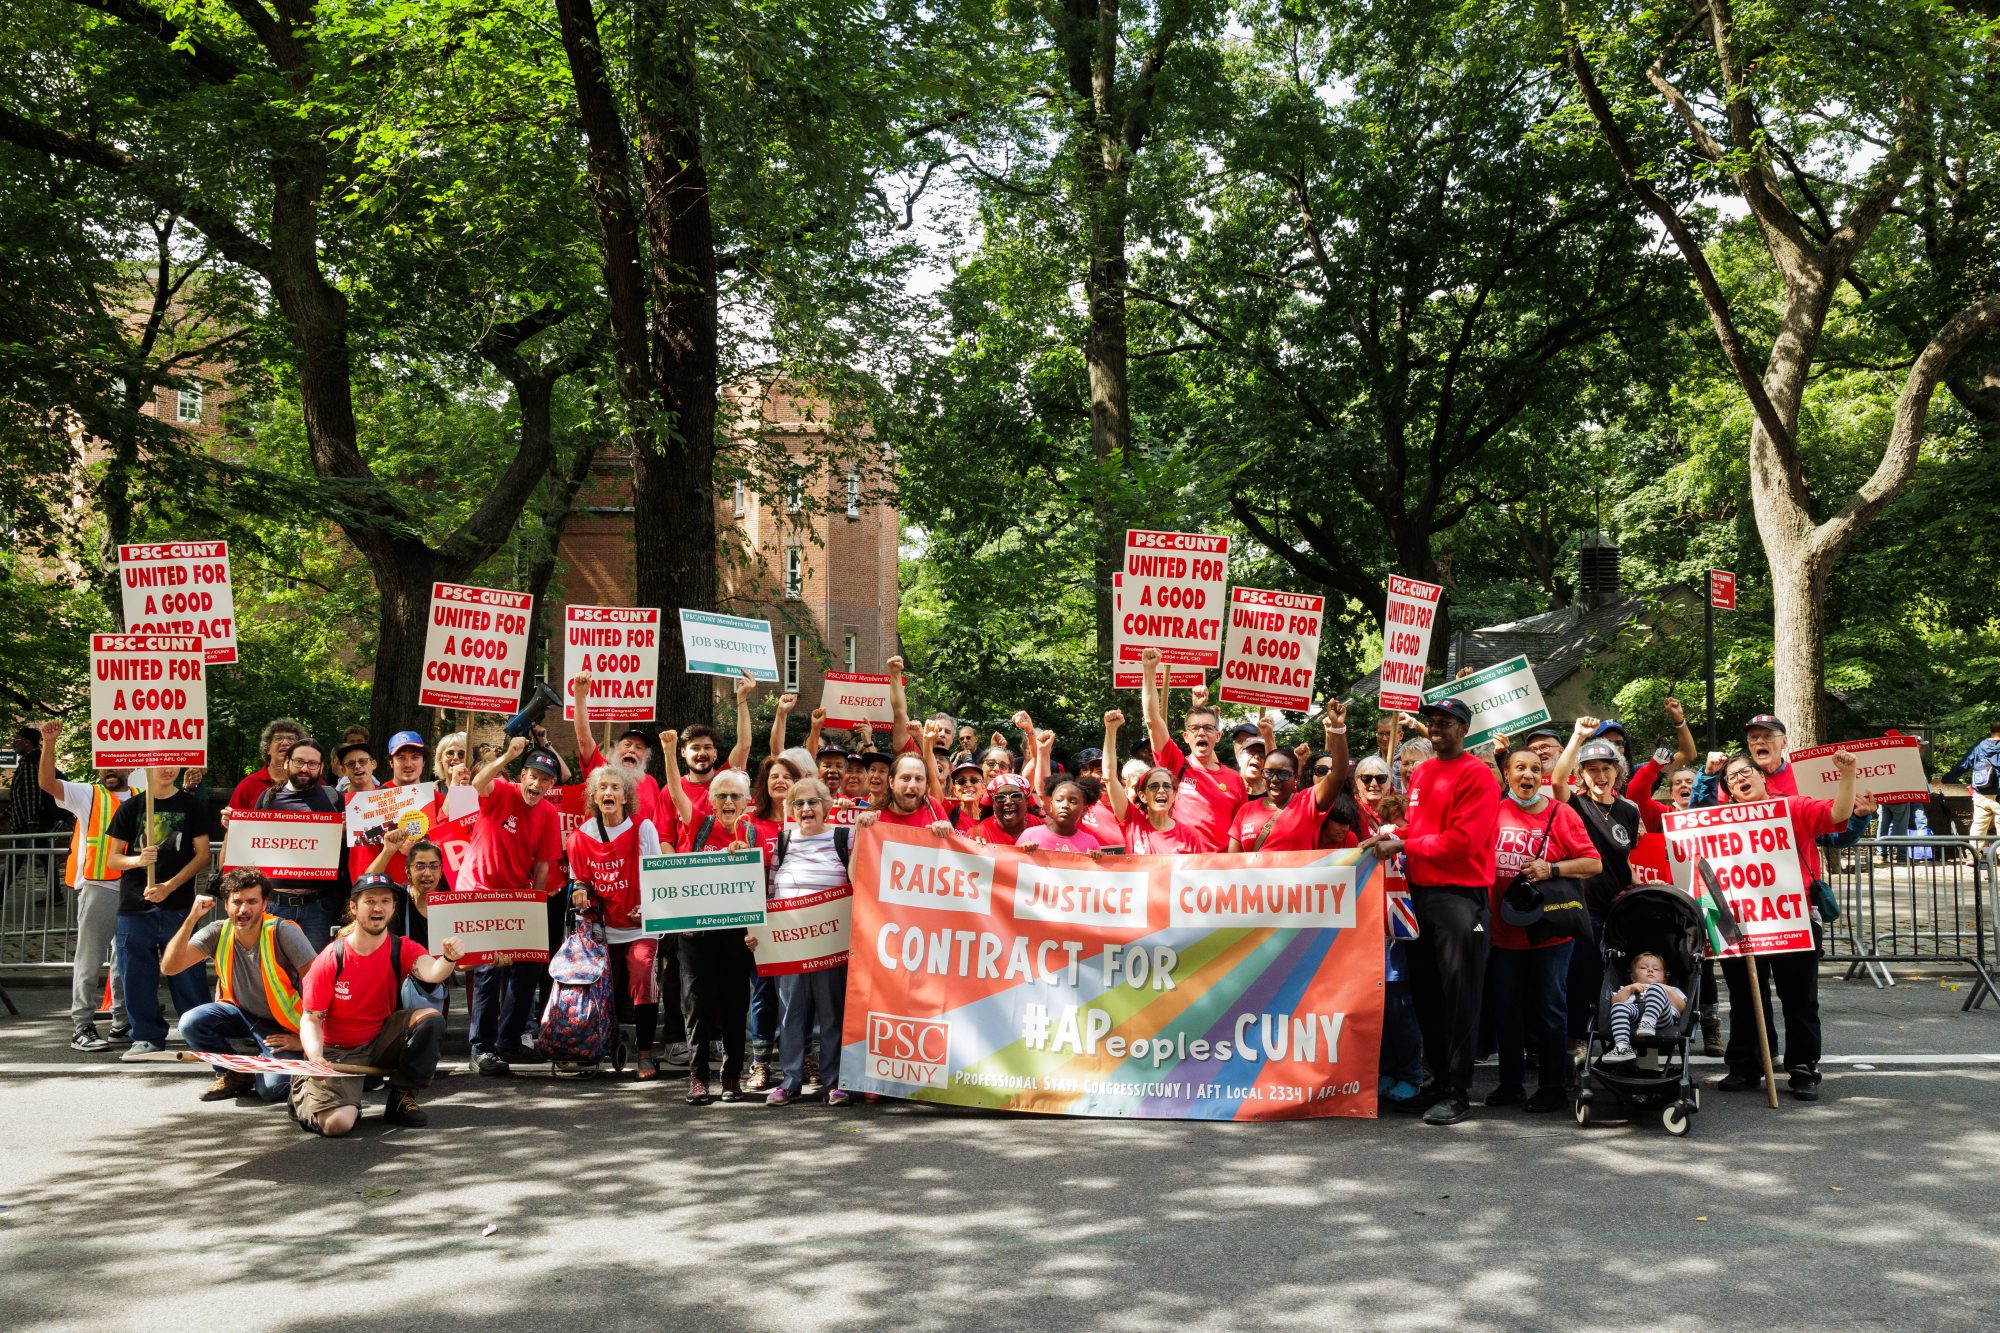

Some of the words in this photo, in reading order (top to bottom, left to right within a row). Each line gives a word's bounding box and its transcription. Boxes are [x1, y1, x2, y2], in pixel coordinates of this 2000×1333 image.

[128, 544, 218, 560] PSC-CUNY
[1136, 534, 1221, 551] PSC-CUNY
[125, 565, 188, 589] UNITED
[193, 564, 226, 585] FOR
[1129, 555, 1187, 579] UNITED
[1192, 559, 1223, 582] FOR
[441, 586, 525, 607] PSC-CUNY
[1140, 585, 1152, 607] A
[1157, 586, 1206, 610] GOOD
[1240, 590, 1317, 610] PSC-CUNY
[1392, 578, 1436, 600] PSC-CUNY
[144, 594, 158, 615] A
[161, 592, 213, 615] GOOD
[434, 606, 491, 631] UNITED
[495, 613, 526, 636] FOR
[574, 609, 651, 622] PSC-CUNY
[716, 617, 744, 628] Members
[744, 622, 760, 630] Want
[1233, 608, 1285, 632] UNITED
[1289, 615, 1318, 637] FOR
[1388, 600, 1416, 626] UNITED
[1416, 606, 1433, 630] FOR
[569, 627, 623, 647] UNITED
[627, 629, 655, 648] FOR
[1123, 613, 1220, 641] CONTRACT
[101, 637, 196, 651] PSC-CUNY
[443, 635, 456, 656] A
[461, 637, 508, 661] GOOD
[691, 635, 712, 647] JOB
[713, 638, 768, 655] SECURITY
[1242, 636, 1252, 655] A
[1257, 638, 1301, 661] GOOD
[1390, 631, 1395, 652] A
[1396, 632, 1420, 657] GOOD
[96, 659, 163, 681] UNITED
[169, 659, 202, 681] FOR
[581, 653, 593, 672] A
[597, 653, 641, 673] GOOD
[1225, 660, 1312, 688] CONTRACT
[1382, 660, 1423, 687] CONTRACT
[426, 660, 521, 690] CONTRACT
[827, 672, 858, 681] PSC/CUNY
[859, 675, 883, 683] Members
[1427, 683, 1463, 701] PSC/CUNY
[1463, 672, 1496, 687] Members
[1496, 663, 1516, 674] Want
[567, 678, 654, 699] CNTRACT
[113, 689, 127, 711] A
[131, 689, 187, 711] GOOD
[839, 695, 886, 707] RESPECT
[96, 719, 204, 742] CONTRACT
[1791, 745, 1836, 761] PSC/CUNY
[1838, 741, 1879, 752] Members
[1880, 738, 1905, 746] Want
[1820, 763, 1897, 784] REPECT
[231, 811, 273, 819] PSC/CUNY
[363, 811, 375, 820] NEW
[375, 807, 389, 816] YORK
[388, 800, 406, 811] HEALTH
[405, 798, 415, 806] ACT
[1673, 803, 1777, 830] PSC-CUNY
[250, 837, 319, 850] RESPECT
[1496, 830, 1545, 858] PSC
[1748, 826, 1791, 854] FOR
[646, 858, 688, 868] PSC/CUNY
[689, 855, 726, 865] Members
[727, 854, 748, 862] Want
[1498, 853, 1528, 867] CUN
[272, 869, 337, 877] #APeoplesCUNY
[1715, 862, 1776, 892] GOOD
[429, 892, 473, 903] PSC/CUNY
[474, 891, 513, 900] Members
[652, 886, 678, 902] JOB
[681, 880, 756, 898] SECURITY
[784, 894, 823, 908] Members
[824, 888, 847, 899] Want
[889, 859, 980, 900] RAISES
[1025, 881, 1133, 914] JUSTICE
[1179, 883, 1346, 915] COMMUNITY
[696, 913, 761, 925] #APeoplesCUNY
[1728, 893, 1803, 924] TRACT
[453, 918, 526, 934] RESPECT
[772, 918, 840, 943] RESPECT
[1747, 935, 1779, 943] Congress
[877, 922, 1083, 987] CONTRACT
[1103, 943, 1178, 992] FOR
[870, 1018, 945, 1063] PSC
[1021, 1002, 1345, 1069] #APeoplesCUNY
[876, 1058, 938, 1084] CUNY
[1196, 1083, 1221, 1099] AFT
[1226, 1084, 1263, 1100] LOCAL
[1269, 1085, 1302, 1102] 2334
[1316, 1080, 1360, 1100] AFL-CIO
